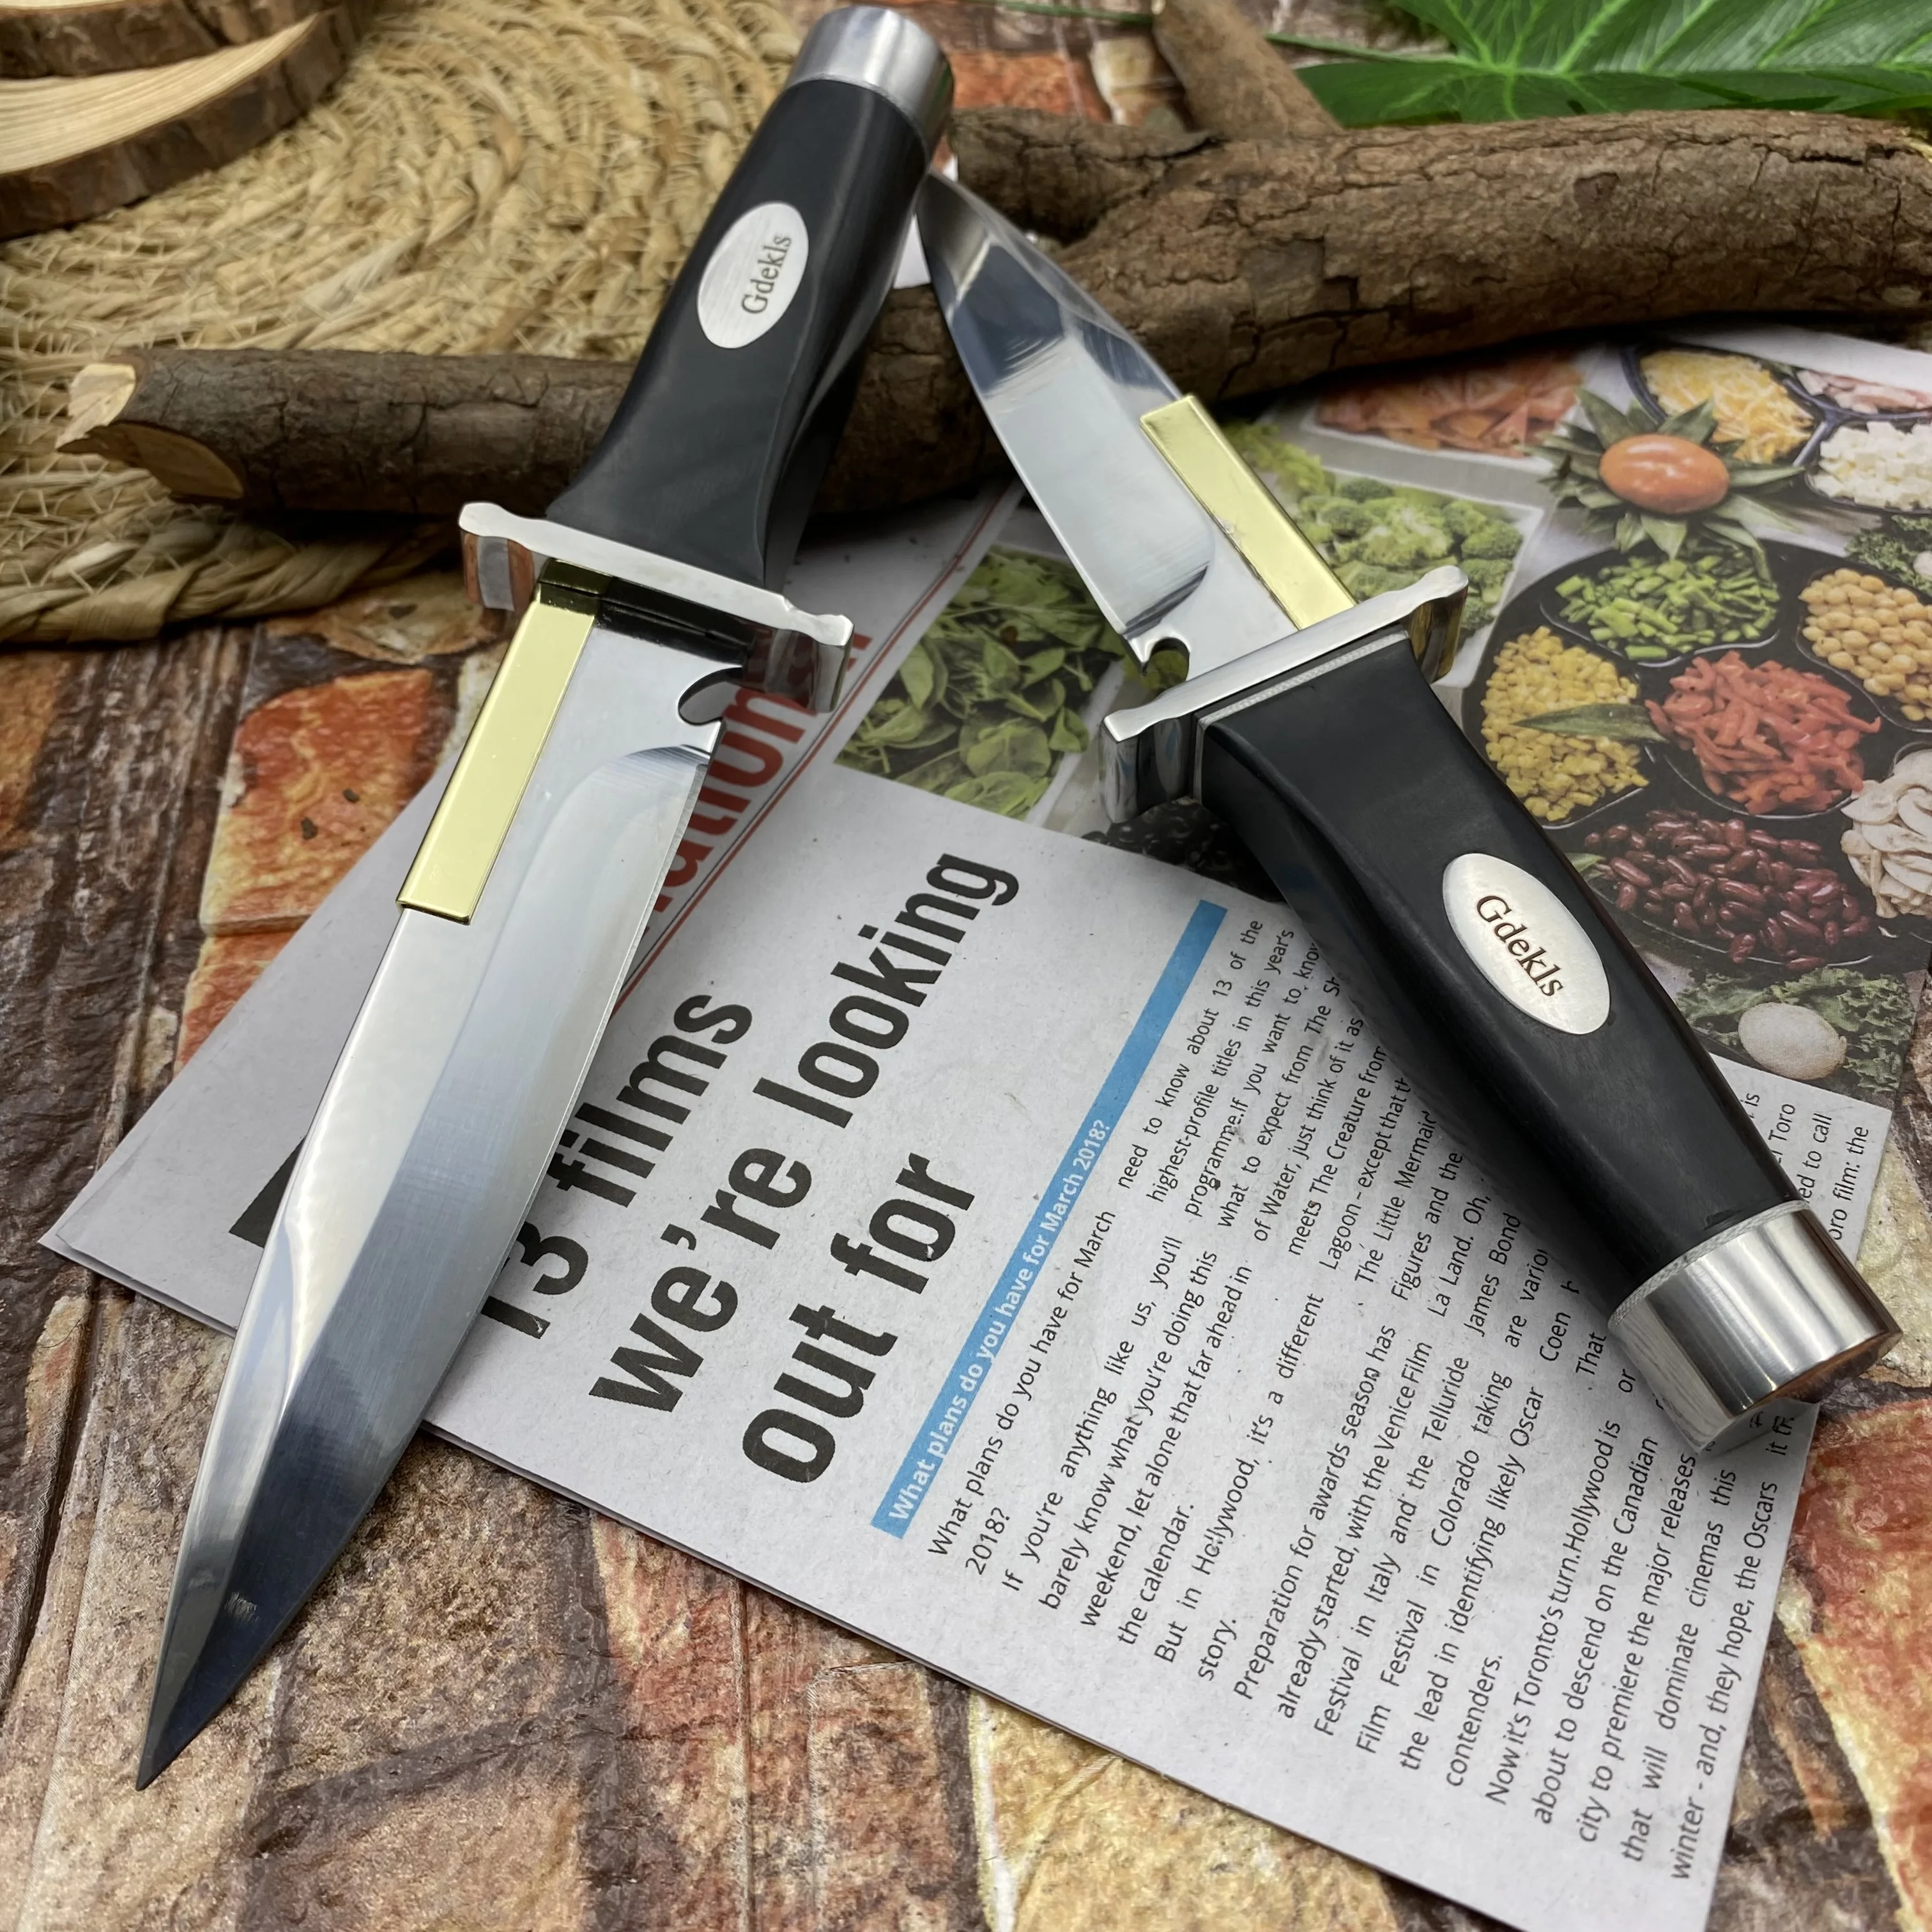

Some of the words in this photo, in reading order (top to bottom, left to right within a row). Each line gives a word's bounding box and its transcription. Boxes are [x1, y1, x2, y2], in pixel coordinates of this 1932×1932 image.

[741, 235, 792, 314] Gdekls
[1476, 895, 1563, 997] Gdekls
[1117, 1143, 1149, 1190] need
[1141, 1117, 1163, 1135] to
[1154, 1062, 1191, 1108] know
[1186, 1008, 1220, 1055] about
[1211, 979, 1233, 997] 13
[1229, 950, 1247, 970] of
[1239, 920, 1264, 945] the
[1145, 1084, 1220, 1204] highest-profile
[1210, 1038, 1242, 1077] titles
[1243, 978, 1271, 1008] this
[1263, 929, 1295, 976] year's
[1242, 1062, 1268, 1096] you
[1261, 1012, 1292, 1054] want
[1282, 988, 1303, 1006] to
[588, 1147, 812, 1413] we're
[752, 853, 1020, 1129] looking
[1216, 1182, 1250, 1227] what
[1240, 1155, 1262, 1174] to
[1256, 1091, 1292, 1146] expect
[1280, 1045, 1314, 1085] from
[1303, 1005, 1332, 1035] The
[1305, 1077, 1338, 1121] think
[1767, 1103, 1796, 1142] Toro
[1811, 1112, 1833, 1144] call
[480, 1220, 588, 1339] 13
[546, 994, 753, 1208] films
[1287, 1123, 1317, 1162] just
[1287, 1199, 1322, 1256] meets
[1308, 1163, 1338, 1195] The
[1326, 1087, 1372, 1160] Creature
[1801, 1150, 1823, 1170] to
[1844, 1126, 1869, 1156] the
[1258, 1162, 1303, 1216] Water,
[1318, 1203, 1362, 1271] Lagoon
[1356, 1130, 1393, 1188] except
[1378, 1093, 1407, 1130] that
[1831, 1161, 1861, 1202] film:
[1253, 1217, 1272, 1242] of
[1353, 1248, 1384, 1284] The
[1372, 1195, 1406, 1242] Little
[1390, 1230, 1432, 1301] Figures
[1424, 1186, 1450, 1225] and
[1438, 1152, 1464, 1181] the
[1438, 1234, 1475, 1286] Land.
[1462, 1195, 1492, 1226] Oh,
[1462, 1273, 1501, 1338] James
[1487, 1211, 1522, 1266] Bond
[742, 1303, 898, 1483] out
[829, 1152, 976, 1295] for
[888, 1458, 936, 1520] What
[926, 1394, 968, 1460] plans
[958, 1363, 984, 1393] do
[975, 1320, 1007, 1365] you
[993, 1268, 1034, 1317] have
[1022, 1234, 1050, 1266] for
[1039, 1173, 1084, 1233] March
[1072, 1119, 1110, 1172] 2018?
[1504, 1314, 1528, 1349] are
[1538, 1311, 1572, 1362] Coen
[927, 1497, 974, 1556] What
[964, 1435, 1004, 1497] plans
[995, 1402, 1020, 1431] do
[1011, 1358, 1043, 1402] you
[1029, 1305, 1069, 1354] have
[1056, 1271, 1084, 1302] for
[1073, 1211, 1117, 1269] March
[1400, 1342, 1433, 1384] Film
[1574, 1331, 1607, 1376] That
[1000, 1568, 1024, 1592] If
[1019, 1491, 1064, 1565] you're
[1059, 1386, 1117, 1478] anything
[1103, 1340, 1135, 1376] like
[1130, 1301, 1158, 1328] us,
[1149, 1235, 1183, 1291] you'll
[1037, 1537, 1090, 1610] barely
[1073, 1473, 1116, 1535] know
[1106, 1414, 1144, 1469] what
[1133, 1350, 1173, 1417] you're
[1162, 1288, 1205, 1346] doing
[1188, 1250, 1218, 1286] this
[1373, 1384, 1416, 1450] Venice
[1509, 1385, 1545, 1447] Oscar
[1597, 1420, 1621, 1439] is
[1079, 1524, 1143, 1627] weekend,
[1125, 1487, 1155, 1519] let
[1144, 1427, 1182, 1487] alone
[1169, 1380, 1203, 1424] that
[1187, 1348, 1214, 1381] far
[1205, 1284, 1243, 1349] ahead
[1153, 1620, 1188, 1664] But
[1176, 1587, 1202, 1610] in
[1191, 1457, 1261, 1575] Hollywood,
[1246, 1414, 1274, 1445] it's
[1275, 1292, 1324, 1379] different
[1361, 1455, 1390, 1491] the
[1485, 1453, 1526, 1511] likely
[1612, 1437, 1659, 1535] Canadian
[1708, 1469, 1737, 1506] this
[1232, 1564, 1303, 1700] Preparation
[1289, 1523, 1317, 1559] for
[1308, 1442, 1351, 1521] awards
[1340, 1367, 1381, 1439] season
[1365, 1324, 1397, 1363] has
[1345, 1494, 1376, 1540] with
[1659, 1452, 1697, 1540] releases
[1742, 1481, 1779, 1549] Oscars
[964, 1506, 1011, 1576] 2018?
[1117, 1606, 1148, 1645] the
[1138, 1505, 1195, 1603] calendar.
[1313, 1646, 1363, 1736] Festival
[1363, 1552, 1402, 1603] Italy
[1389, 1492, 1418, 1545] and
[1405, 1454, 1434, 1491] the
[1421, 1356, 1469, 1441] Telluride
[1355, 1704, 1392, 1754] Film
[1379, 1598, 1427, 1687] Festival
[1415, 1563, 1441, 1586] in
[1430, 1449, 1480, 1547] Colorado
[1470, 1370, 1514, 1435] taking
[1443, 1515, 1506, 1634] identifying
[1600, 1541, 1629, 1577] the
[1641, 1542, 1673, 1607] major
[1684, 1520, 1724, 1607] cinemas
[1733, 1555, 1761, 1591] the
[1312, 1545, 1360, 1630] started,
[1594, 1583, 1617, 1613] on
[1197, 1619, 1238, 1682] story.
[1512, 1605, 1565, 1707] Toronto's
[1561, 1616, 1607, 1710] descend
[1627, 1611, 1655, 1647] the
[1715, 1598, 1755, 1659] hope,
[1276, 1629, 1327, 1719] already
[1413, 1669, 1449, 1722] lead
[1601, 1652, 1644, 1761] premiere
[1653, 1623, 1699, 1730] dominate
[1705, 1662, 1742, 1714] they
[1399, 1731, 1430, 1770] the
[1446, 1655, 1503, 1787] contenders.
[1502, 1712, 1532, 1745] it's
[1554, 1717, 1577, 1742] to
[1696, 1724, 1727, 1777] and,
[1484, 1747, 1521, 1805] Now
[1531, 1747, 1570, 1825] about
[1590, 1765, 1613, 1791] to
[1641, 1745, 1668, 1790] will
[1575, 1796, 1611, 1843] city
[1620, 1808, 1653, 1862] that
[1670, 1796, 1705, 1879] winter
